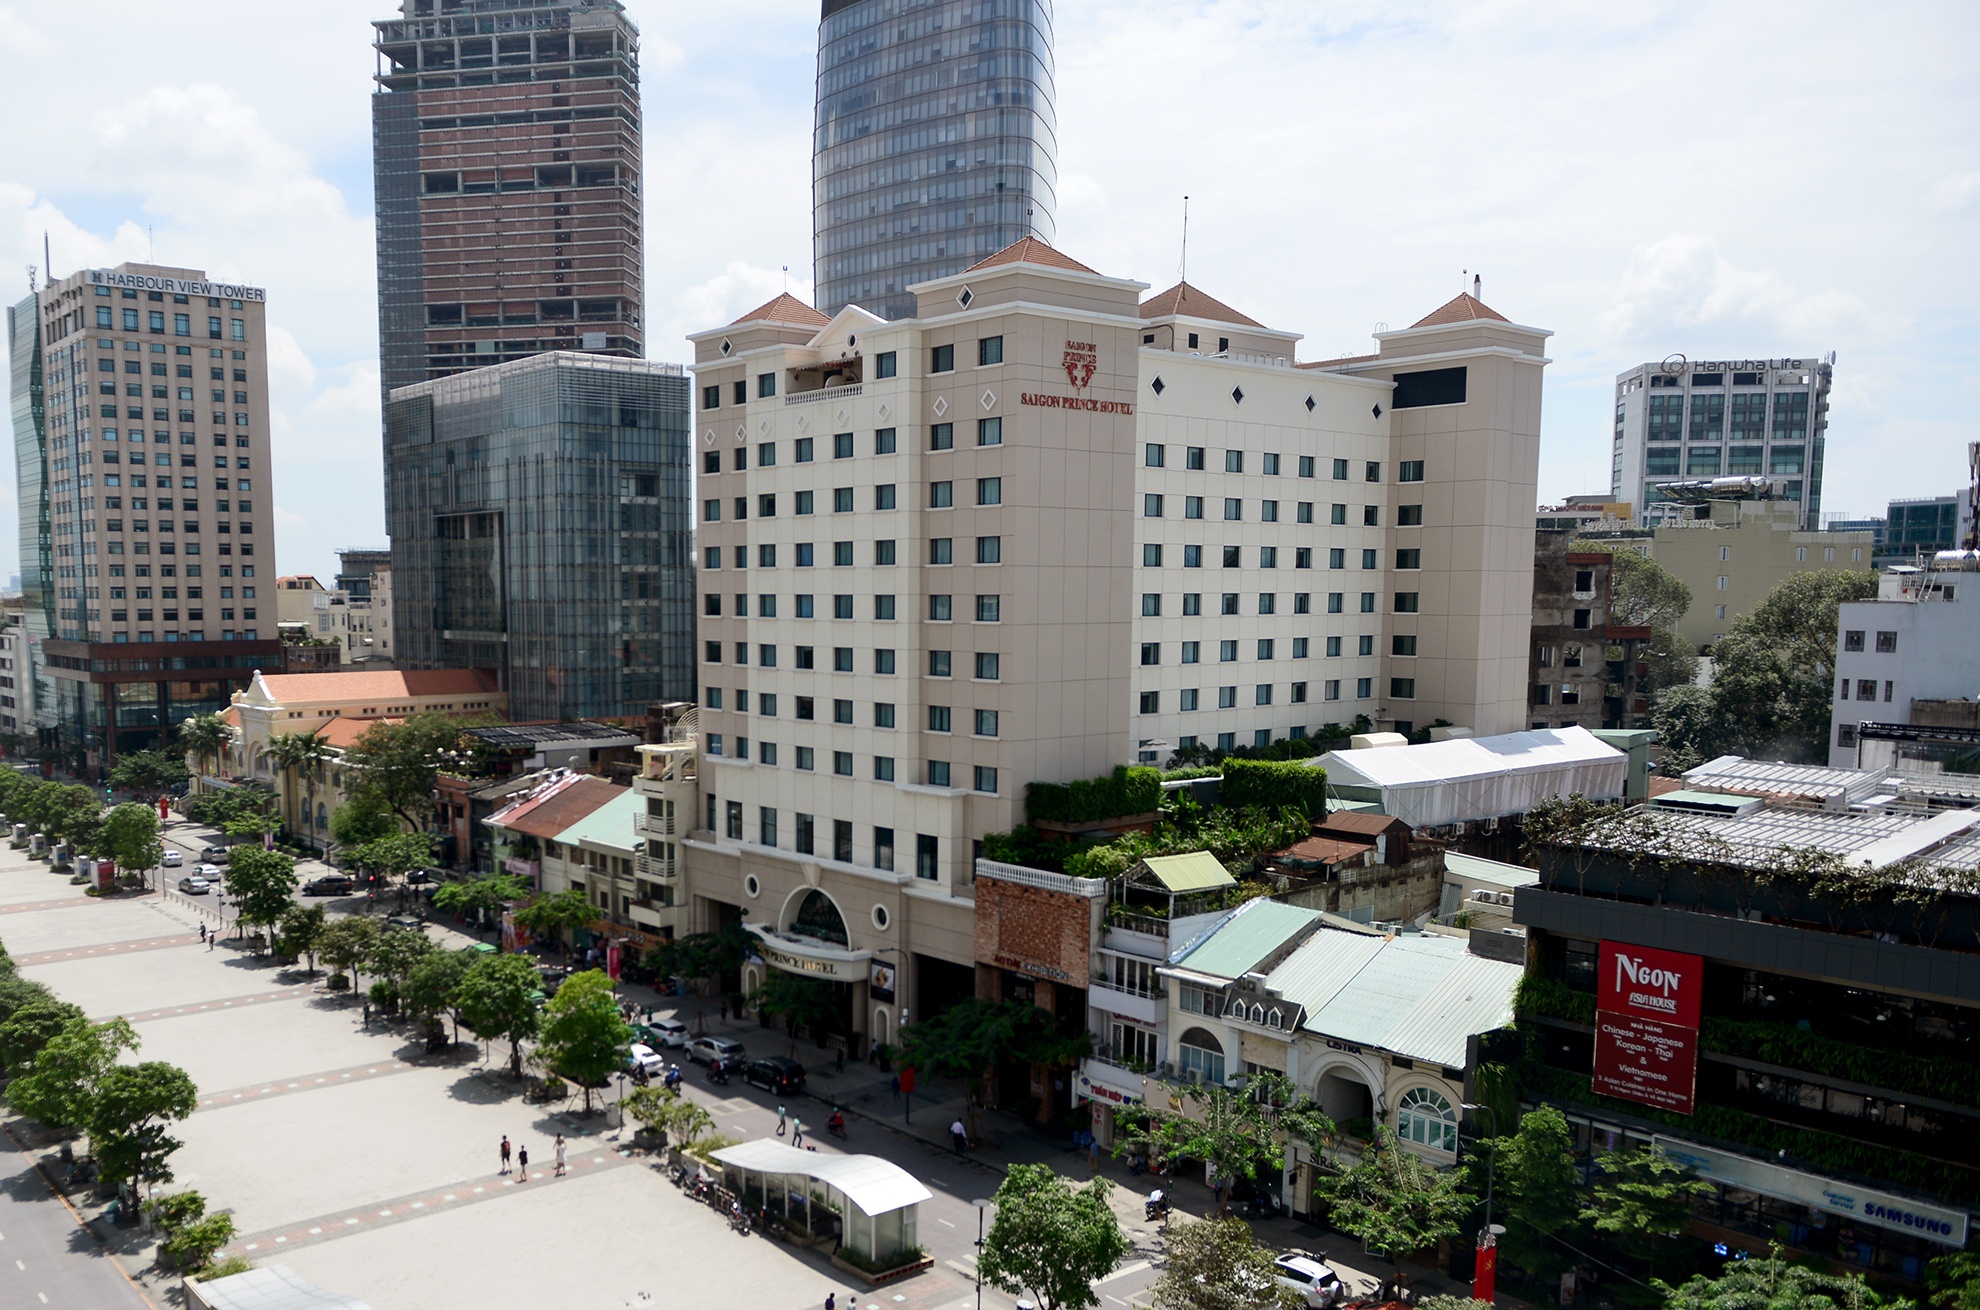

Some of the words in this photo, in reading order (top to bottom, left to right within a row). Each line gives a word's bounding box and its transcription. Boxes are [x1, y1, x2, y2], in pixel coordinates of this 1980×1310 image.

[106, 272, 174, 291] HARBOUR
[178, 280, 212, 295] VIEW
[216, 284, 263, 300] TOWER
[1066, 340, 1097, 353] SAIGON
[1063, 351, 1097, 364] PRINCE
[1694, 359, 1766, 372] Hanwha
[1770, 357, 1803, 370] Life
[1020, 392, 1061, 408] SAIGON
[1061, 396, 1099, 412] PRINCE
[1100, 402, 1133, 415] HOTEL
[771, 950, 800, 968] PRINCE
[801, 960, 838, 975] HOTEL
[1629, 992, 1649, 1004] ASIA
[1650, 995, 1677, 1010] HOUSE
[1601, 1024, 1635, 1038] Chinese
[1642, 1033, 1684, 1048] Japanese
[1615, 1040, 1646, 1053] Korean
[1654, 1047, 1674, 1059] Thai
[1639, 1056, 1648, 1065] &
[1618, 1064, 1668, 1082] Vietnamese
[1604, 1076, 1621, 1086] Asian
[1621, 1080, 1646, 1091] Cuisines
[1654, 1088, 1667, 1096] One
[1668, 1091, 1688, 1101] Home
[1822, 1190, 1854, 1203] Customer
[1829, 1198, 1855, 1210] Service
[1864, 1202, 1953, 1236] SAMSUNG
